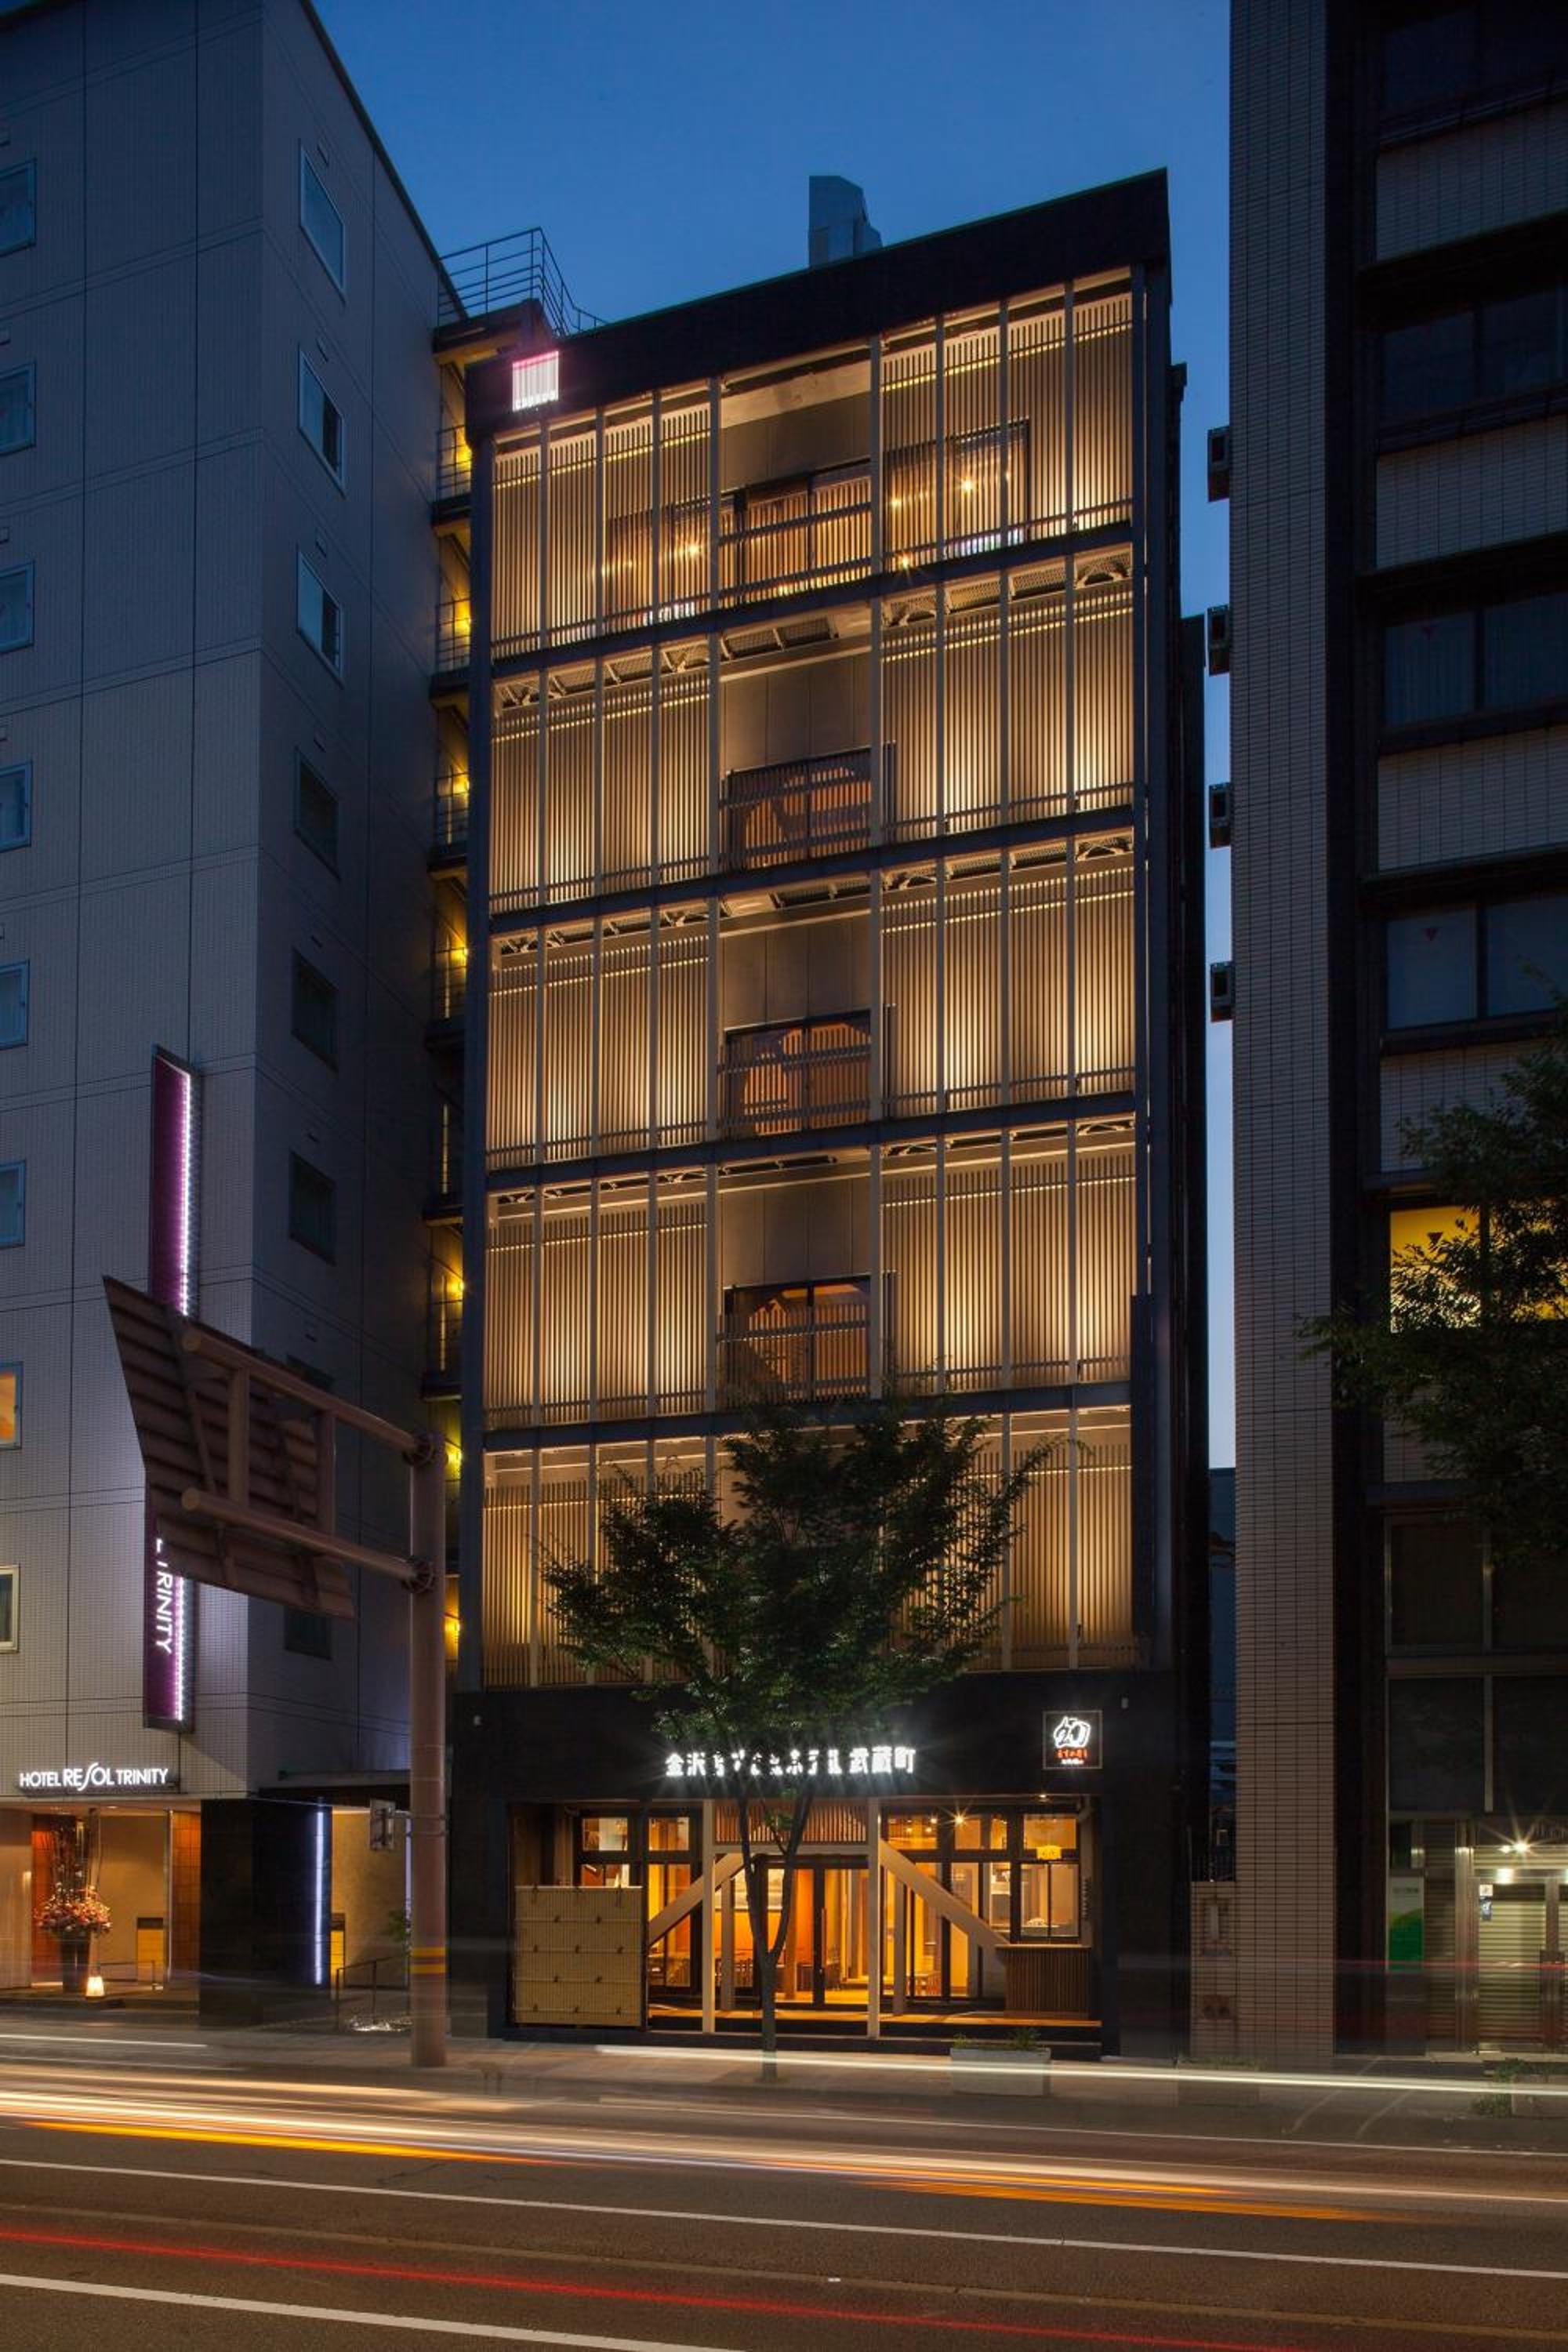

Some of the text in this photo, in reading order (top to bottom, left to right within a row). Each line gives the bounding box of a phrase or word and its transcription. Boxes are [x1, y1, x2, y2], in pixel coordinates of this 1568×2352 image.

[20, 1762, 169, 1791] HOTEL RESOL TRINITY
